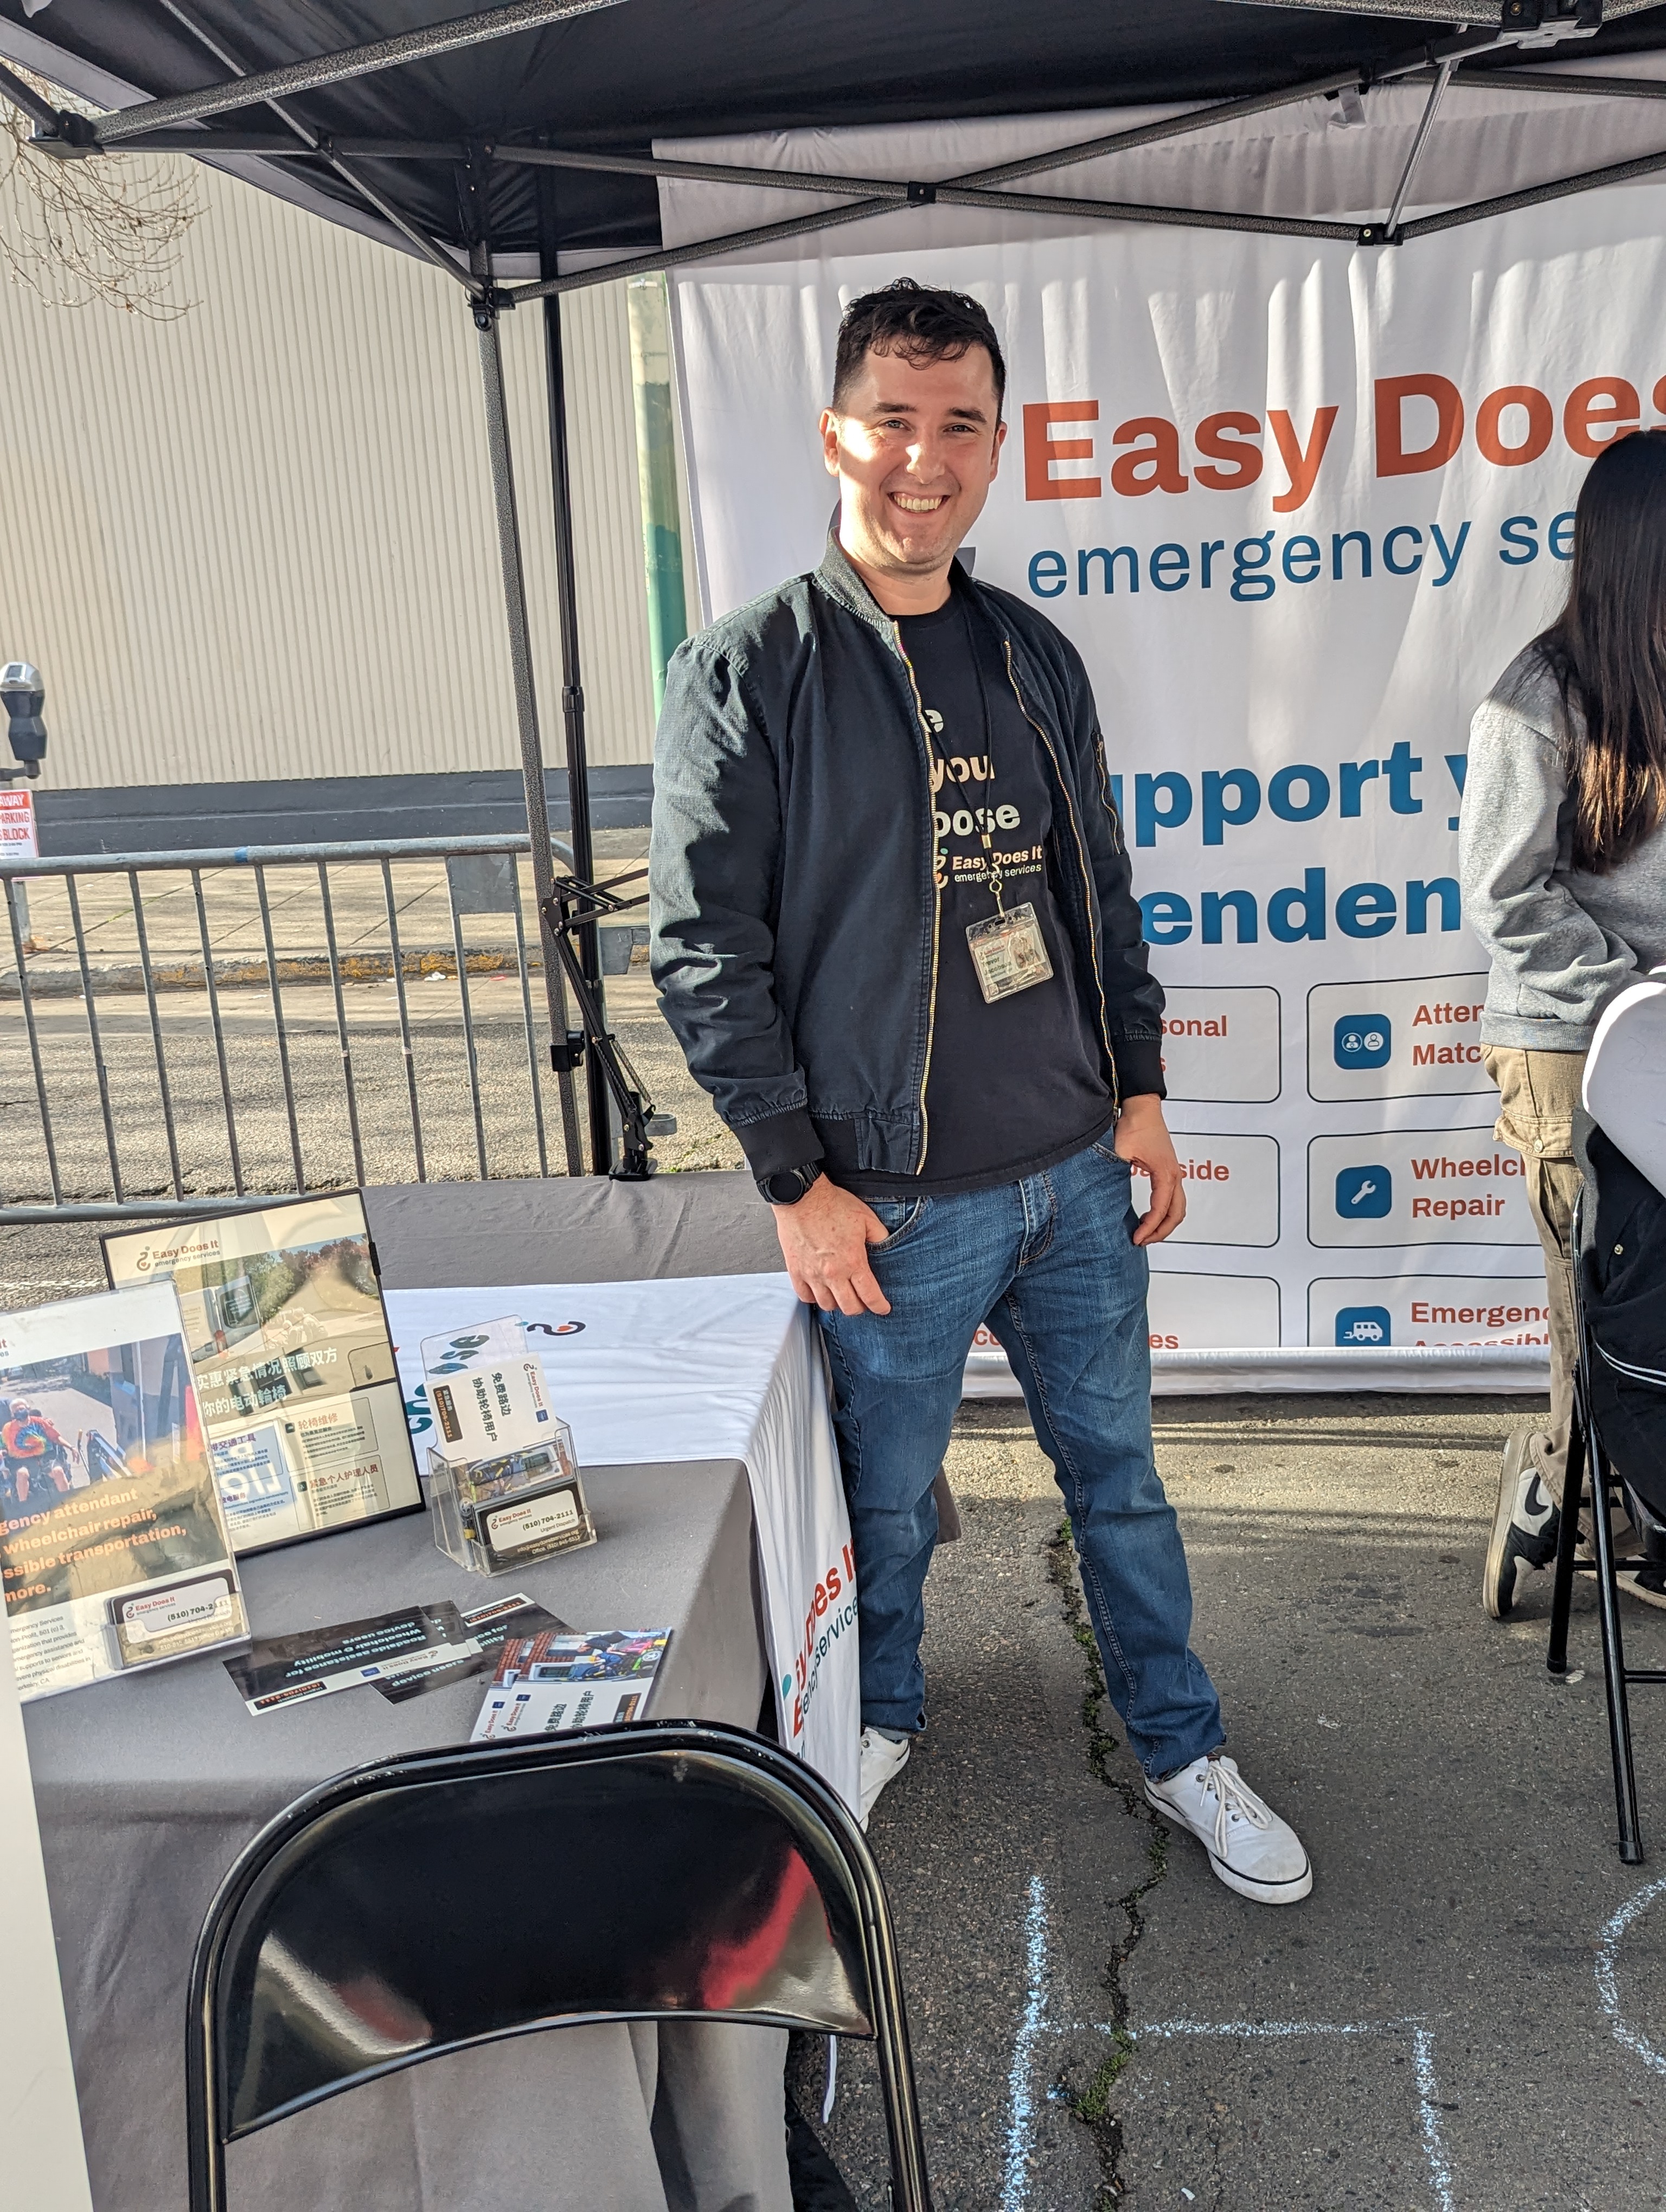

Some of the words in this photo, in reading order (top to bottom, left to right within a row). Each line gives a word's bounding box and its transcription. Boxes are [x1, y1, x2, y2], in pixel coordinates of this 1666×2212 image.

[1022, 400, 1339, 513] Easy
[1375, 373, 1666, 478] Doe
[1028, 520, 1471, 602] emergency
[952, 856, 987, 871] Easy
[993, 850, 1029, 865] Does
[1032, 846, 1042, 860] It
[1005, 864, 1041, 877] services
[1413, 1043, 1481, 1066] Matc
[1412, 1194, 1505, 1220] Repair
[152, 1249, 179, 1259] Easy
[181, 1243, 209, 1254] Does
[210, 1240, 219, 1248] It
[155, 1256, 191, 1267] emergency
[193, 1250, 220, 1260] services
[491, 1372, 511, 1416] 免费路边
[472, 1377, 498, 1442] 协助轮椅用户
[310, 1464, 379, 1489] 紧急个人护理人员
[54, 1488, 138, 1520] attendant
[512, 1510, 526, 1519] Does
[523, 1520, 541, 1531] (510)
[542, 1510, 574, 1524] 704-2111
[556, 1519, 575, 1528] Dispatch
[4, 1521, 101, 1555] wheelchair
[101, 1508, 157, 1529] repair,
[4, 1557, 56, 1579] ssible
[58, 1524, 187, 1564] transportation,
[5, 1583, 51, 1602] more.
[136, 1603, 151, 1611] Easy
[152, 1598, 169, 1606] Does
[168, 1610, 189, 1622] (510)
[190, 1599, 228, 1615] 704-2111
[39, 1616, 64, 1626] Services
[376, 1622, 415, 1635] device
[53, 1631, 77, 1643] provides
[342, 1632, 375, 1644] users
[355, 1628, 421, 1650] Wheelchair
[371, 1635, 427, 1654] Roadside
[44, 1642, 73, 1654] assistance
[20, 1661, 44, 1671] supports
[52, 1652, 72, 1662] seniors
[294, 1649, 342, 1667] mobility
[304, 1650, 370, 1672] assistance
[32, 1667, 55, 1679] physical
[285, 1668, 304, 1679] for
[392, 1670, 432, 1687] device
[433, 1660, 465, 1673] users
